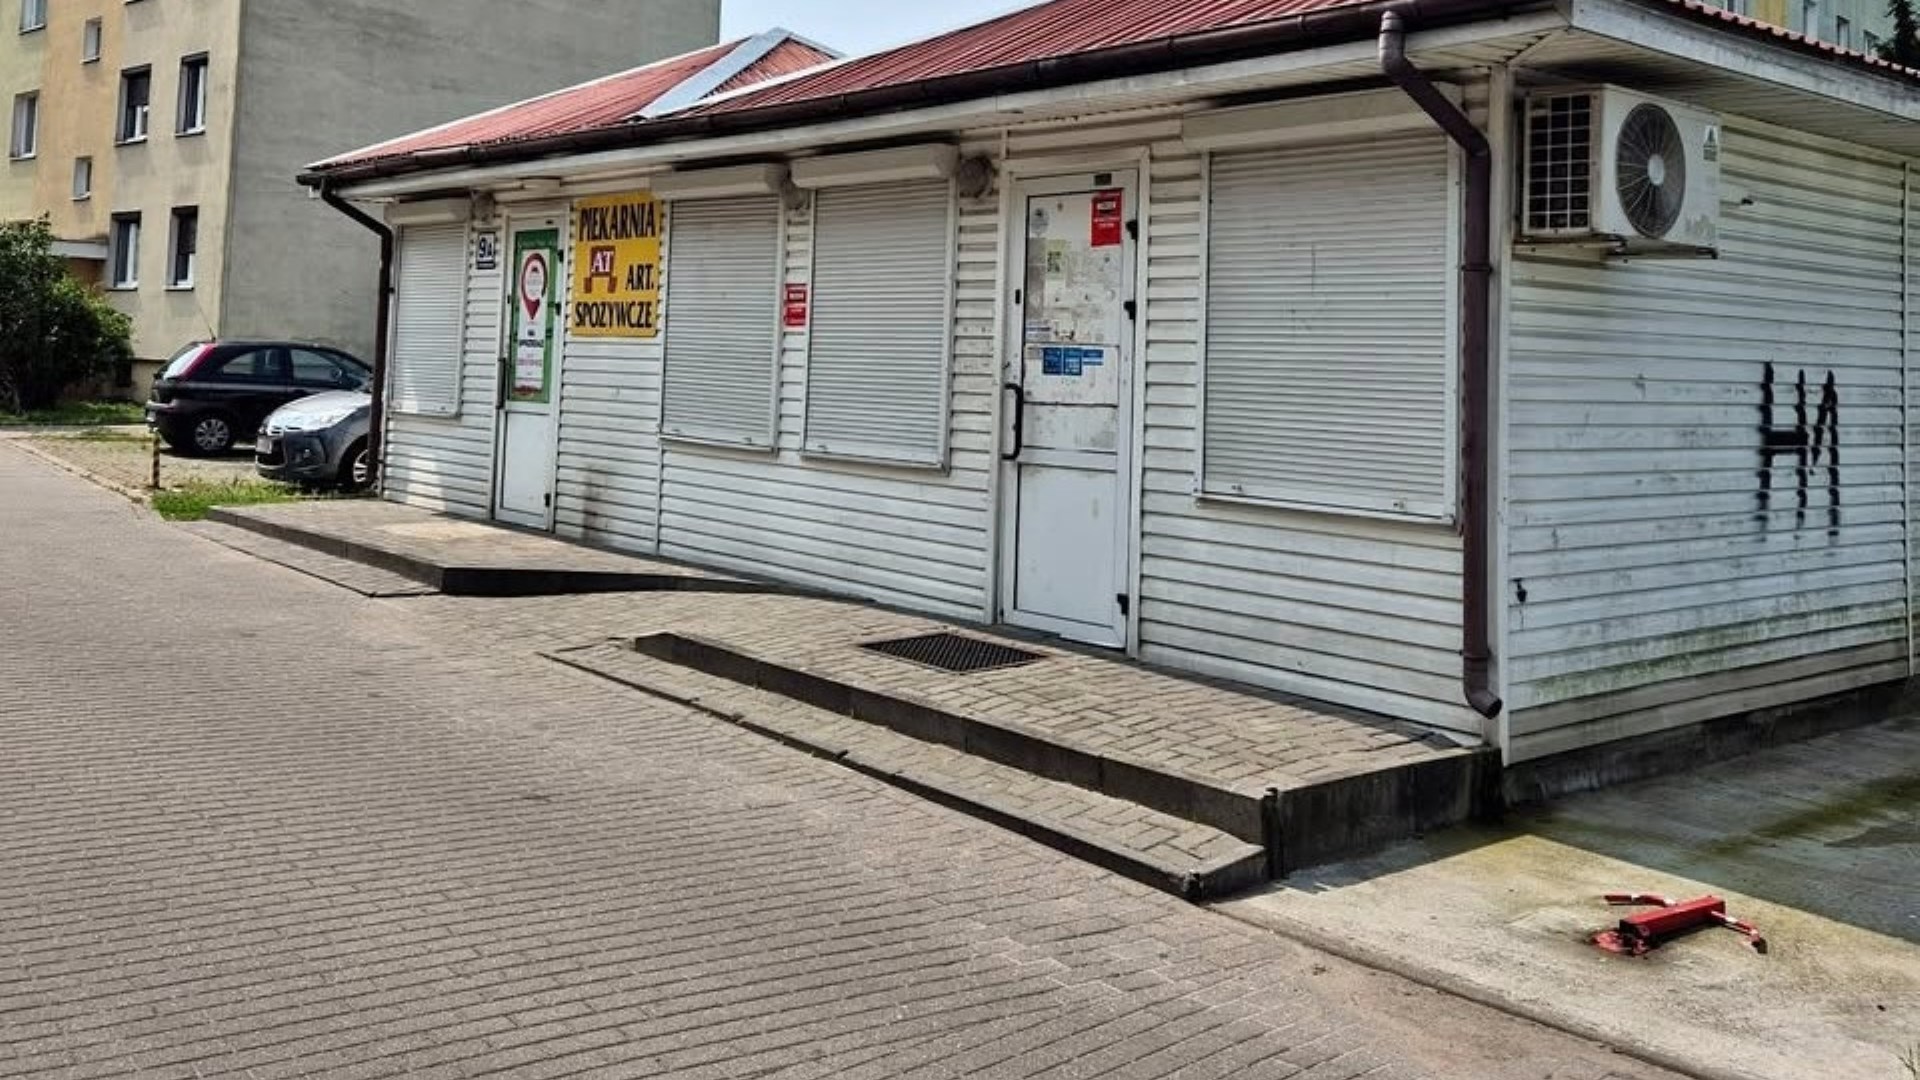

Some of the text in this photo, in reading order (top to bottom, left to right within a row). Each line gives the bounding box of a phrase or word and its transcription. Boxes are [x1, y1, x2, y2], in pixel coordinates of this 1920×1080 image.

[579, 202, 656, 241] PIEKARNIA
[591, 250, 614, 273] AT
[625, 263, 654, 291] ART.
